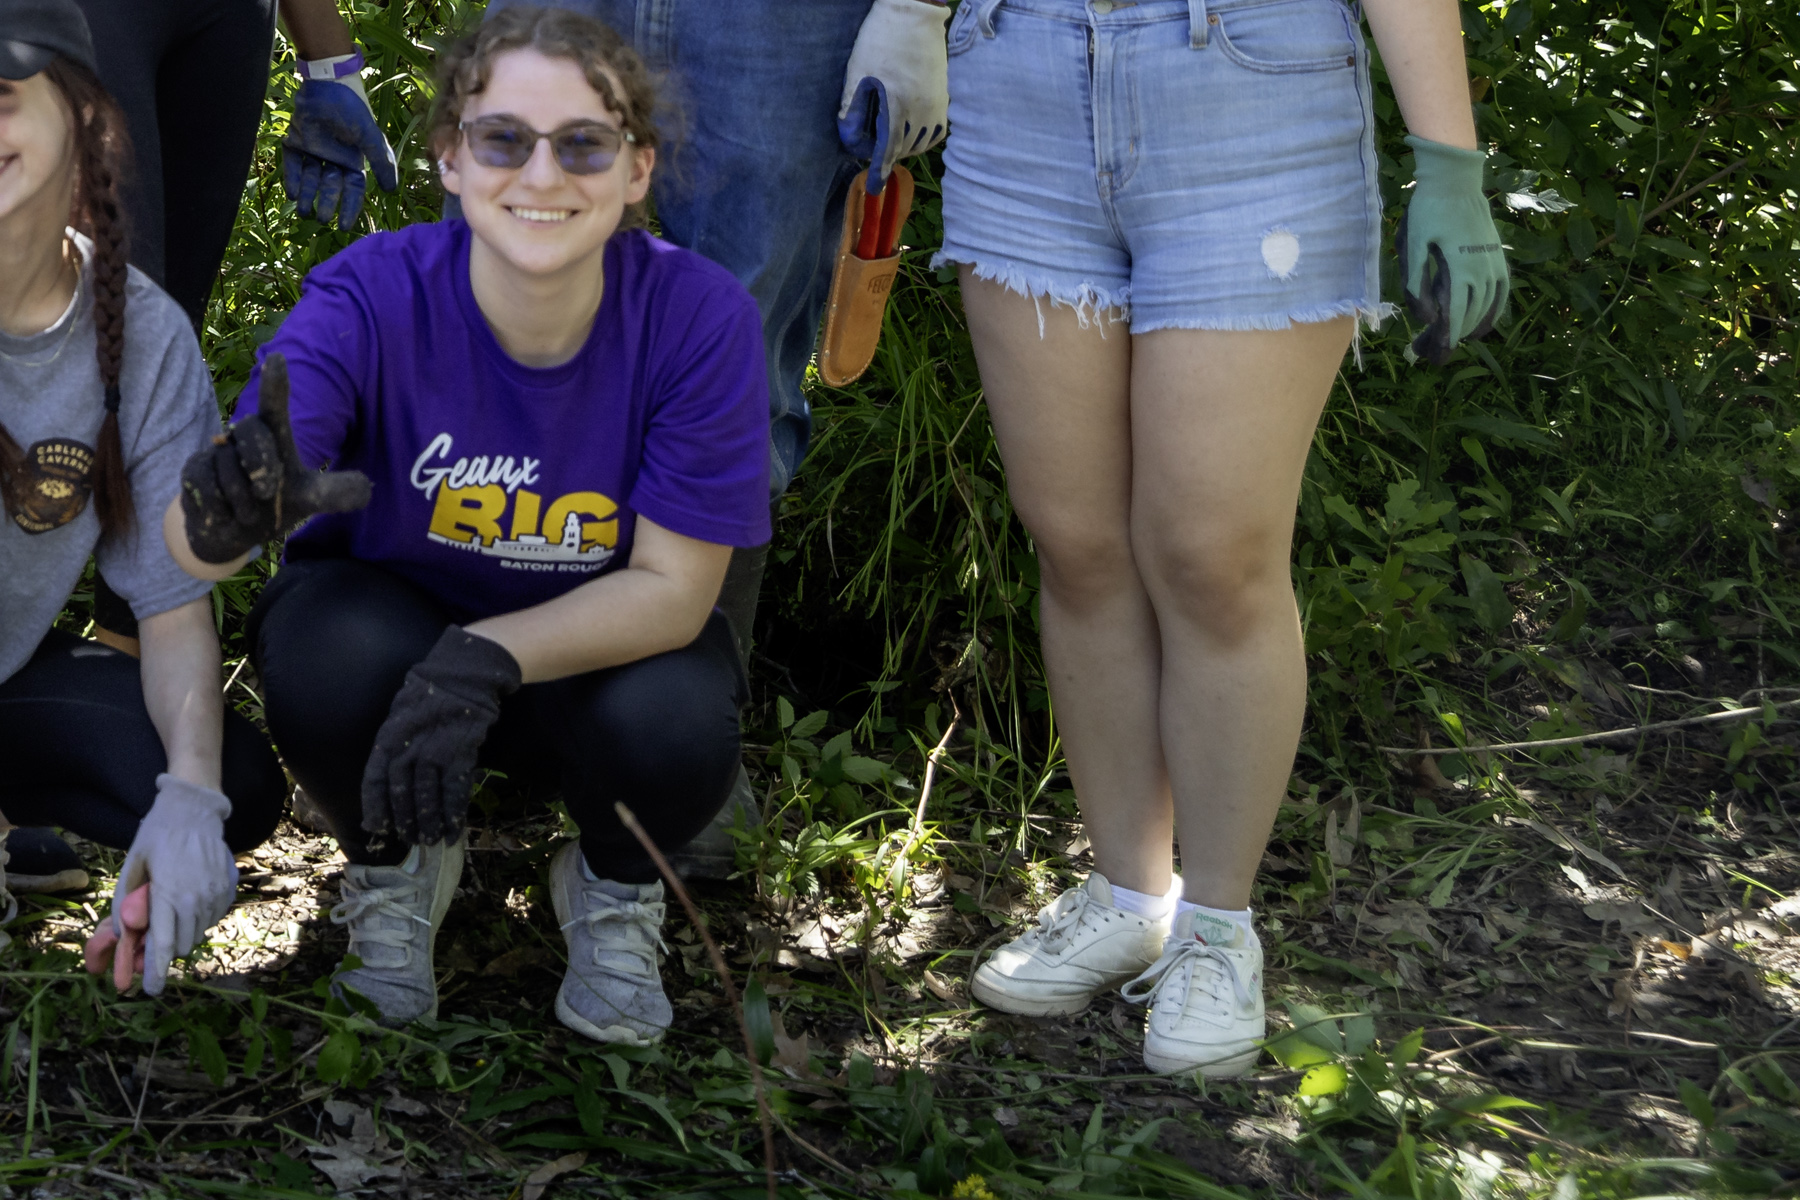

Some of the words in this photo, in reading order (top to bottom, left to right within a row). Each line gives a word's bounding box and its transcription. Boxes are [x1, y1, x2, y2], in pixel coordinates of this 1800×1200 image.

[410, 432, 540, 501] Geaux
[428, 477, 619, 552] BIG
[500, 559, 555, 572] BATON
[1196, 912, 1233, 930] Reebok
